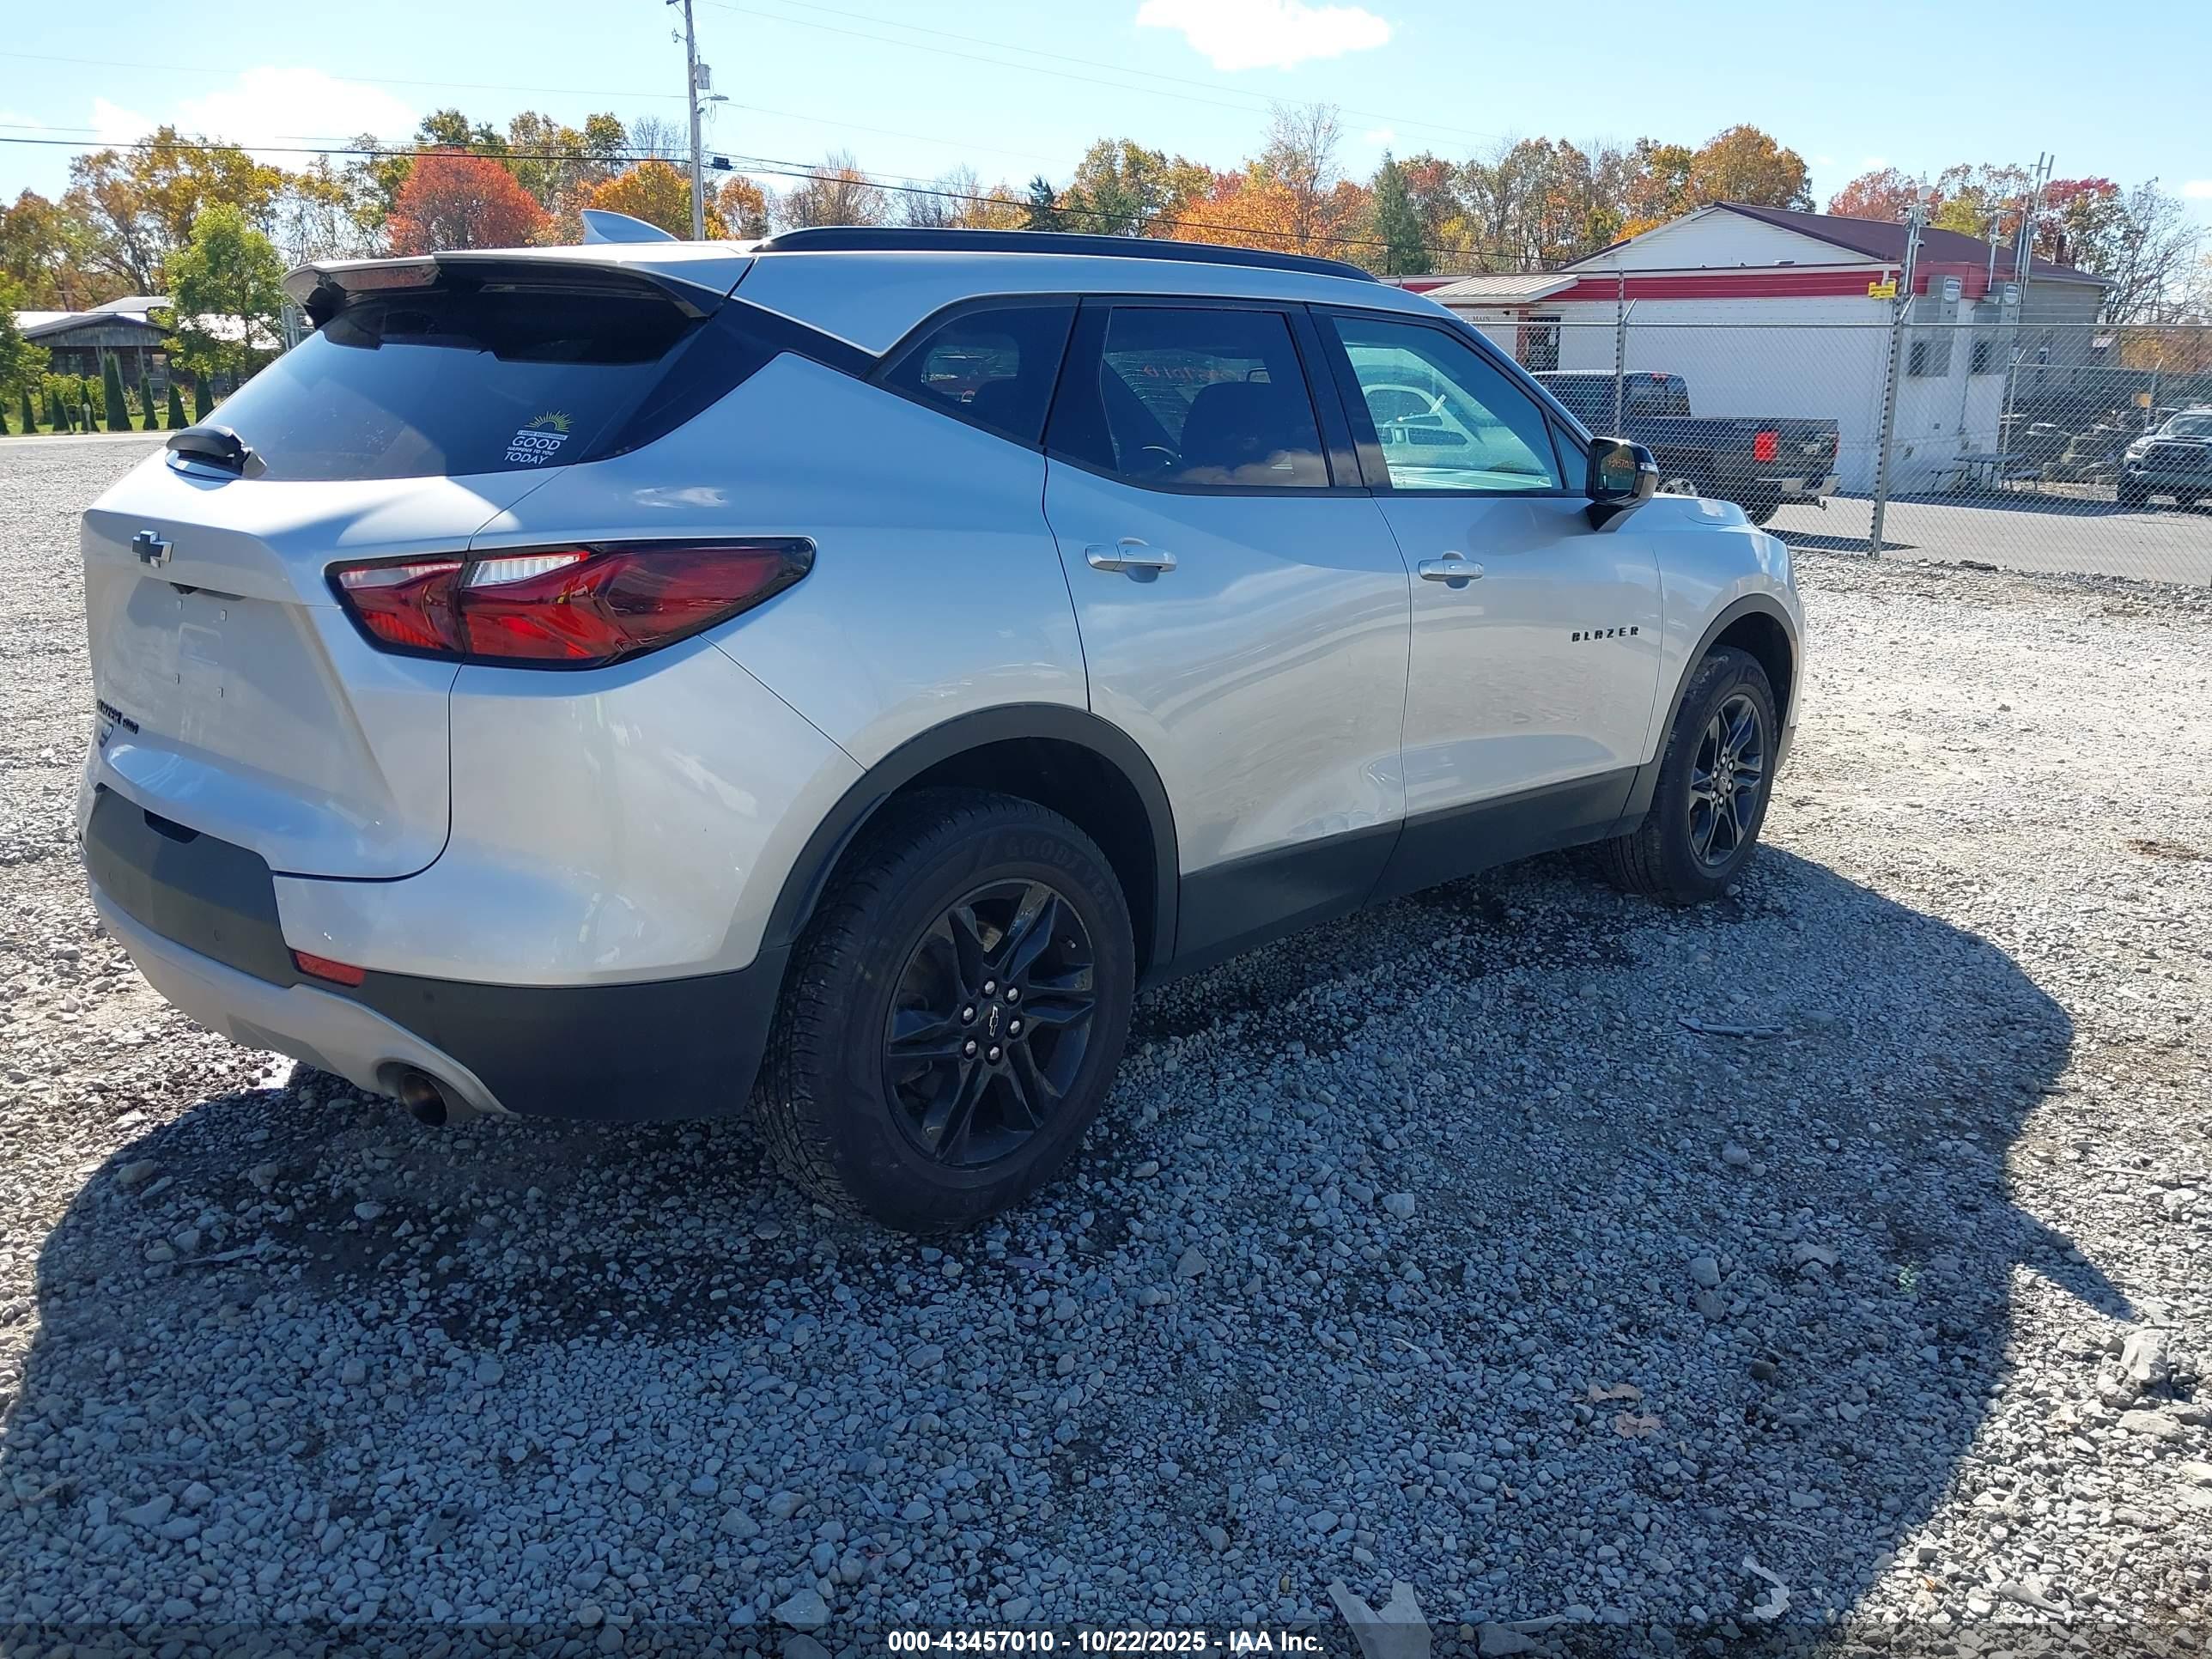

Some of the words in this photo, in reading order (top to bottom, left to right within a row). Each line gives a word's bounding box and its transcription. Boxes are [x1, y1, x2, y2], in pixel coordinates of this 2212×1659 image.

[512, 435, 561, 450] GOOD
[504, 451, 550, 465] TODAY
[1571, 625, 1639, 642] BLAZER
